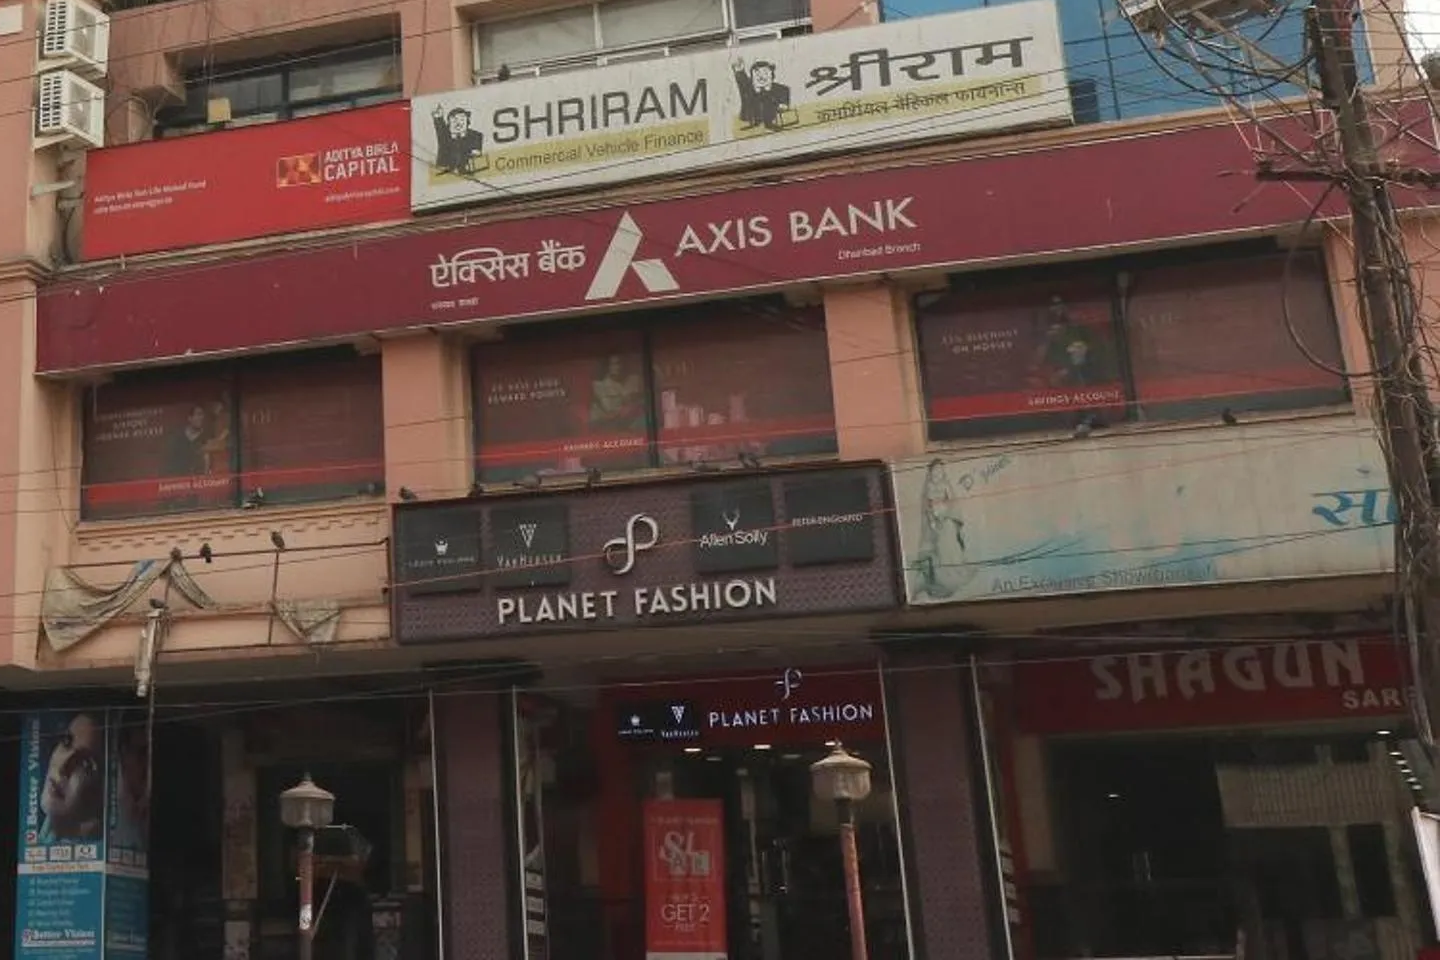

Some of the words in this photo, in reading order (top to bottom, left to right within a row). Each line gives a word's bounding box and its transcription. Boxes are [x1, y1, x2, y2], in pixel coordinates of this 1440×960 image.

[805, 36, 1033, 96] श्रीराम
[492, 79, 708, 144] SHRIRAM
[324, 146, 363, 163] ADITYA
[366, 141, 399, 157] BIRLA
[324, 156, 400, 181] CAPITAL
[495, 146, 581, 171] Commercial
[586, 137, 640, 157] Vehicle
[644, 130, 704, 150] Finance
[673, 216, 772, 257] AXIS
[788, 197, 918, 243] BANK
[429, 247, 530, 287] ऐक्सिस
[537, 240, 586, 273] बैंक
[497, 589, 617, 625] PLANET
[634, 577, 776, 617] FASHION
[1090, 640, 1365, 705] SHAGUN
[709, 707, 779, 729] PLANET
[790, 704, 873, 724] FASHION
[661, 903, 696, 923] GET
